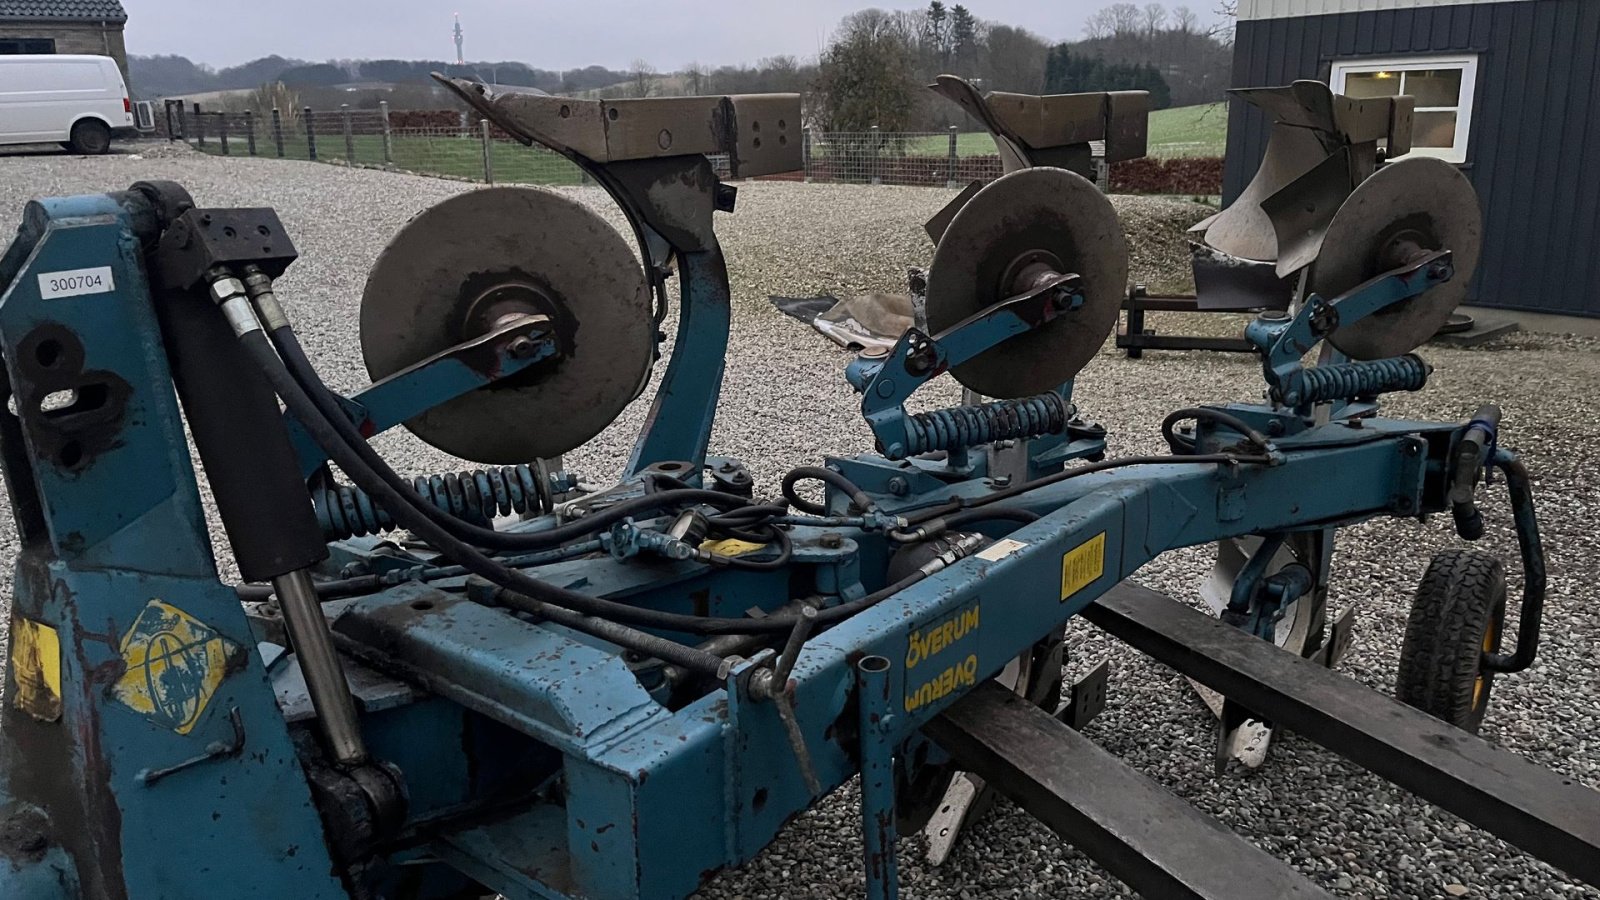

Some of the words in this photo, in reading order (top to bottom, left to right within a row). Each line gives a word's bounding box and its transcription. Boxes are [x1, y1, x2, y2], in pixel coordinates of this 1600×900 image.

[50, 275, 102, 292] 300704
[906, 605, 980, 669] ÖVERUM
[905, 654, 978, 713] ÖVERUM
